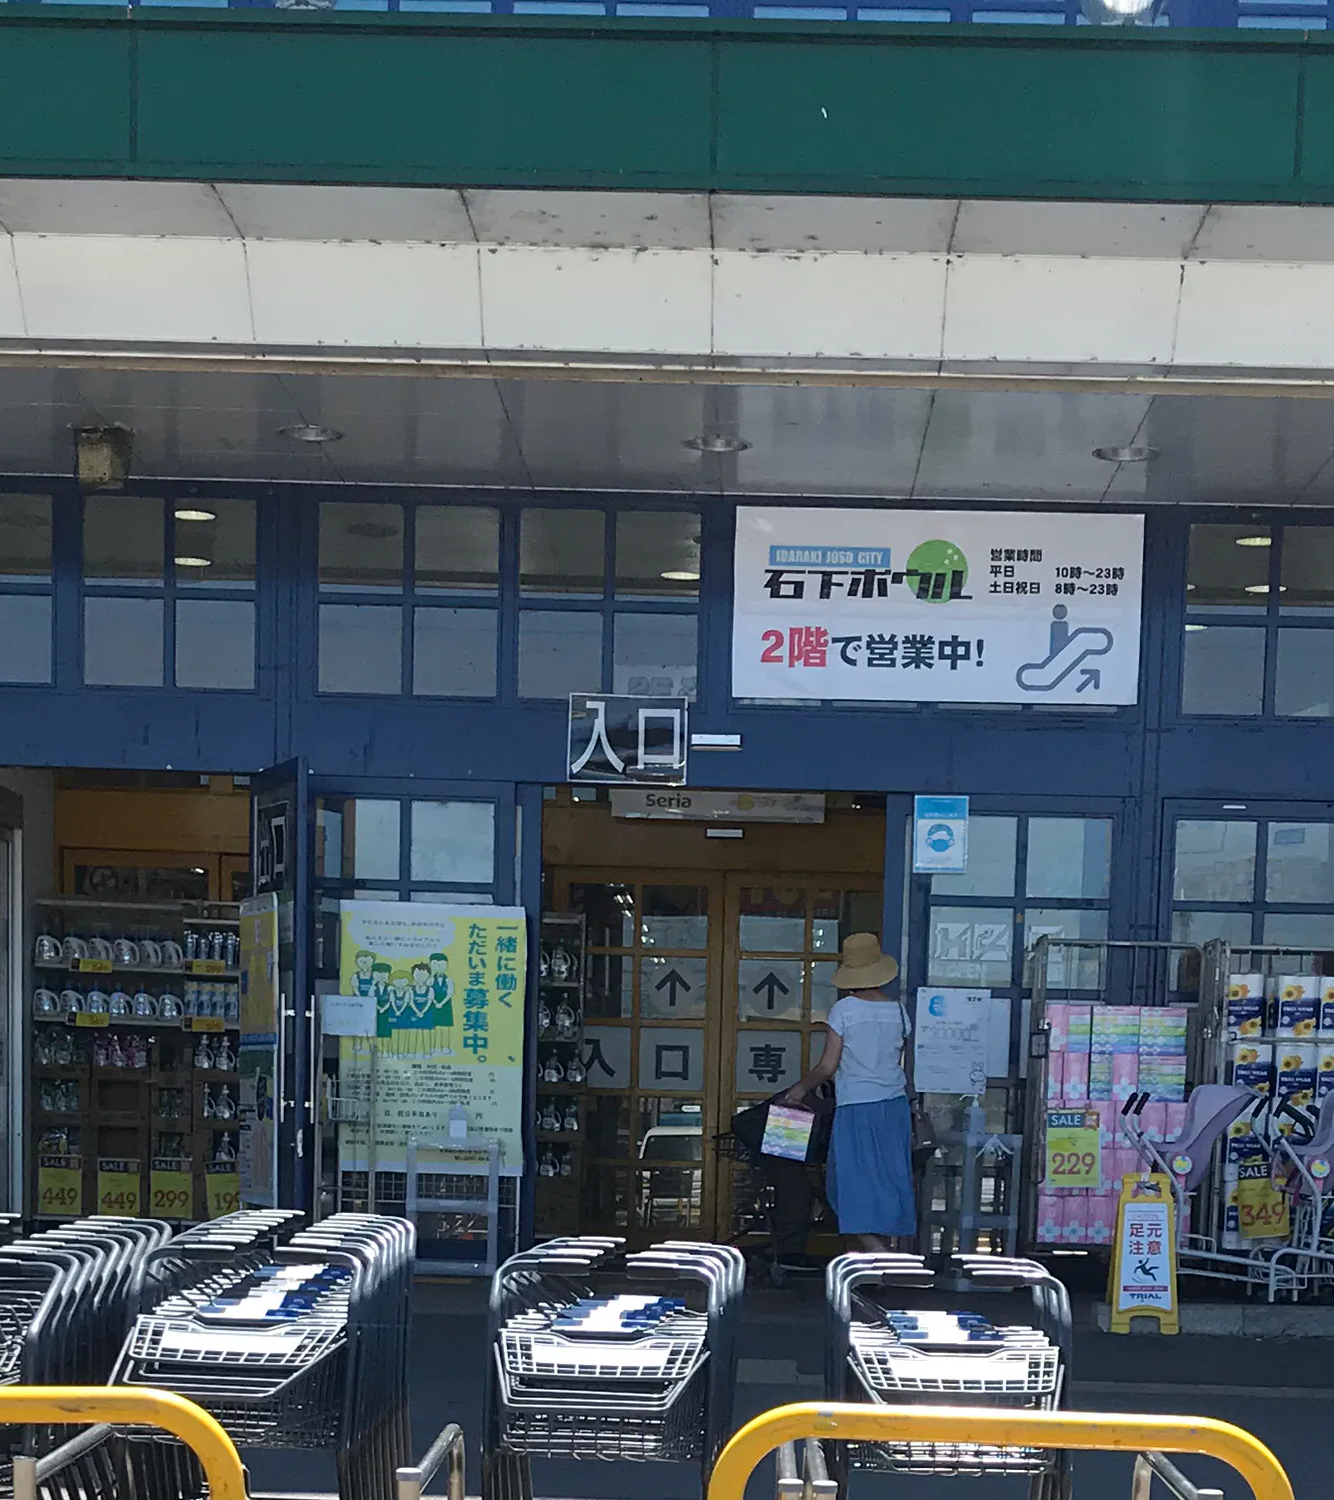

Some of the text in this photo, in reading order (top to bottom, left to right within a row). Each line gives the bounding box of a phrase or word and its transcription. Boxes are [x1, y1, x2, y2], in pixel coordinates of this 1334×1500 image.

[857, 551, 884, 566] CITY
[990, 548, 1043, 563] 営業時間
[989, 564, 1015, 578] 平日
[988, 581, 1041, 595] 土日祝日
[570, 700, 682, 775] 入口
[644, 793, 693, 808] Seria
[1050, 1114, 1082, 1126] SALE
[41, 1157, 66, 1167] SALE
[101, 1161, 126, 1171] SALE
[154, 1159, 178, 1170] SALE
[208, 1163, 233, 1173] SALE
[1051, 1152, 1096, 1176] 229
[1238, 1165, 1268, 1179] SALE
[101, 1191, 137, 1210] 449
[154, 1190, 189, 1209] 299
[1240, 1200, 1286, 1227] 349
[1129, 1223, 1163, 1239] 足元
[1128, 1240, 1163, 1256] 注意
[1128, 1292, 1163, 1300] TRIAL
